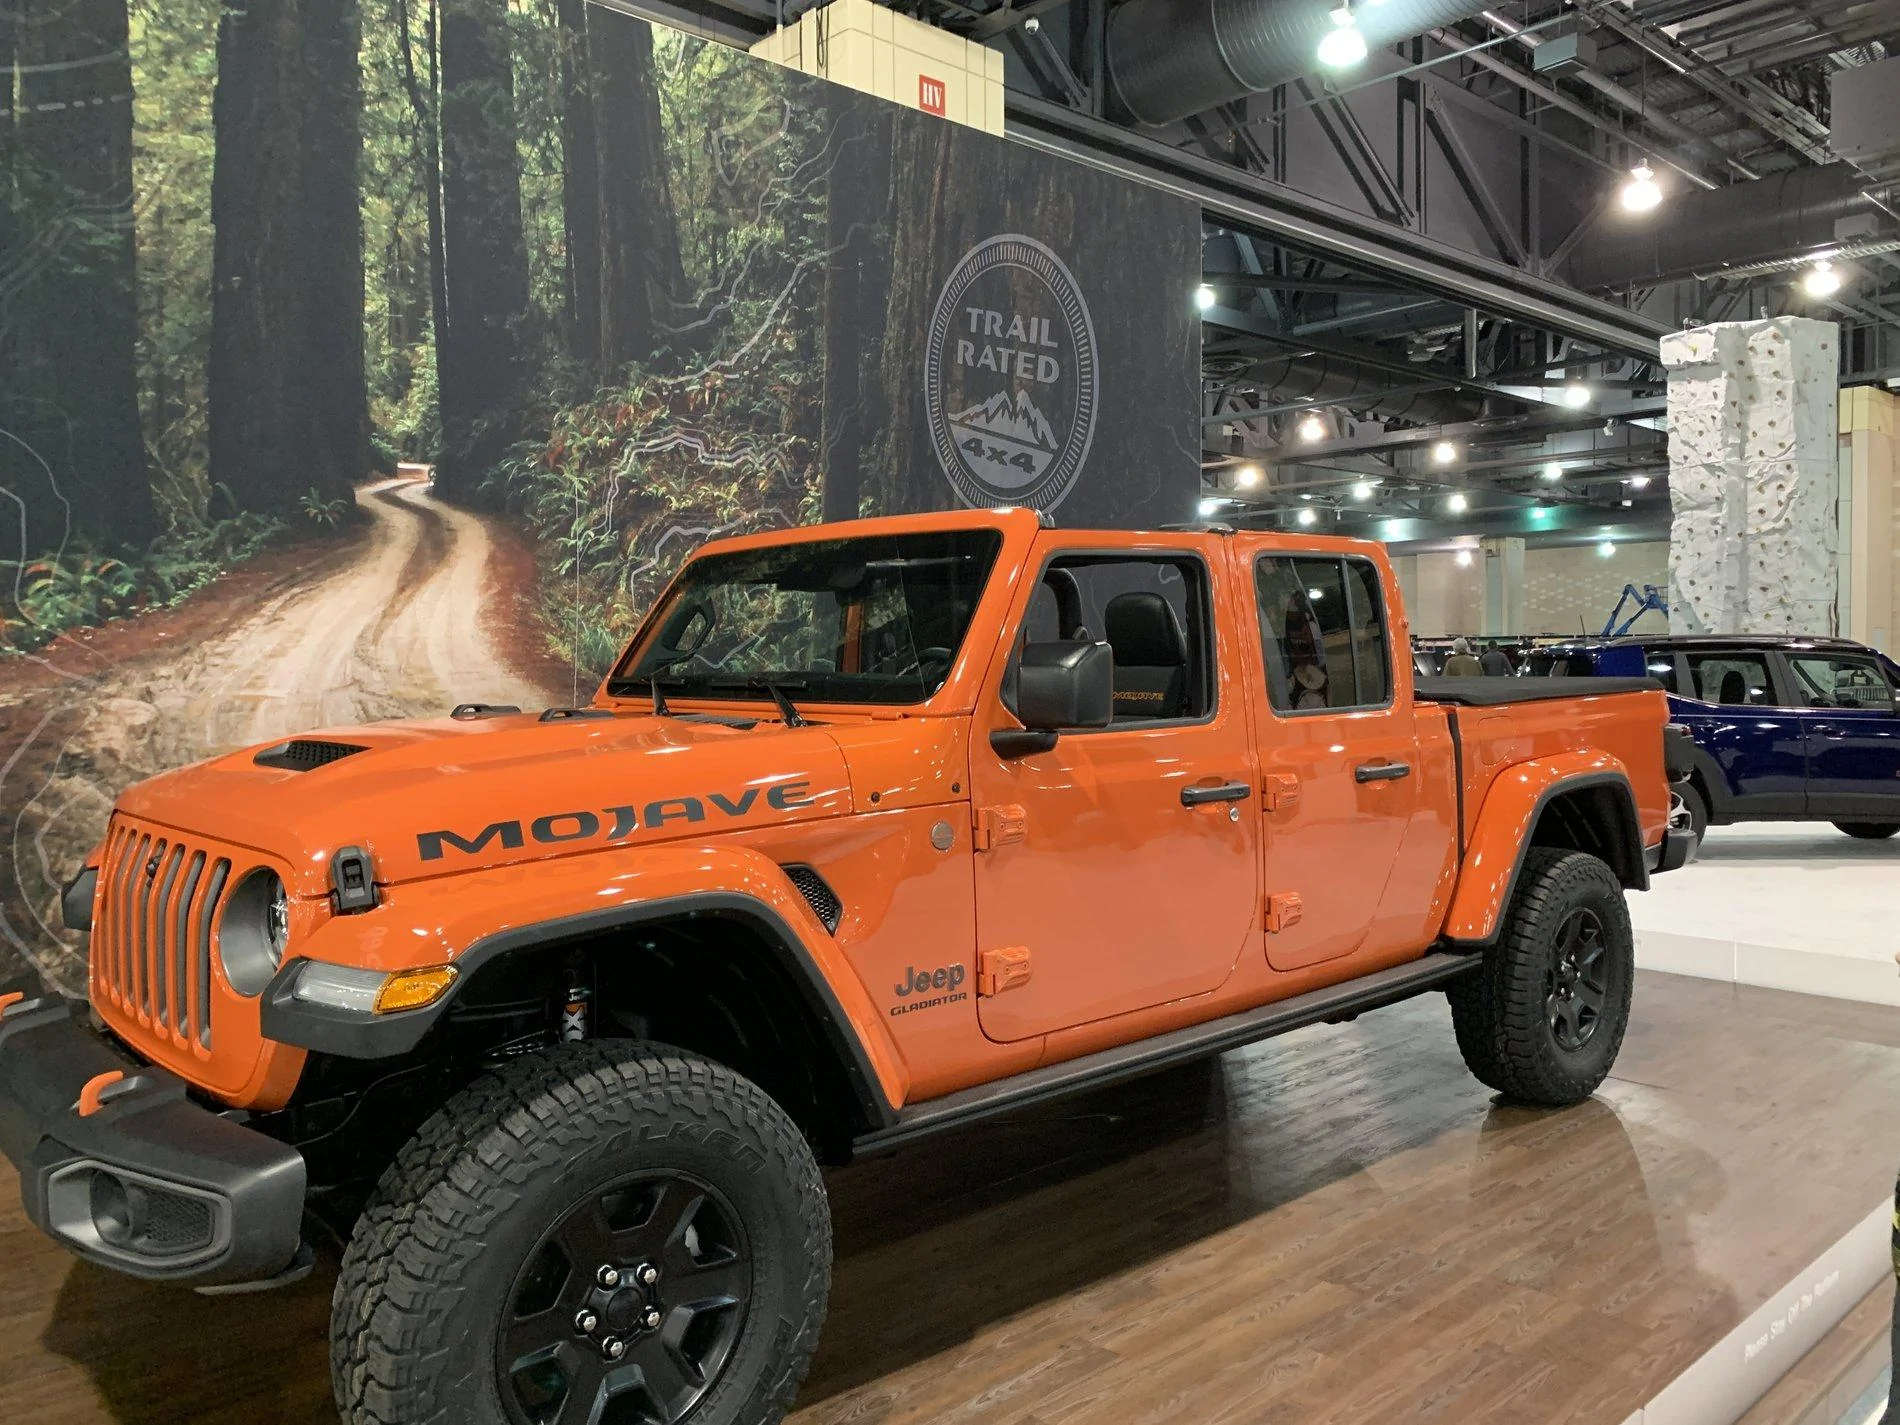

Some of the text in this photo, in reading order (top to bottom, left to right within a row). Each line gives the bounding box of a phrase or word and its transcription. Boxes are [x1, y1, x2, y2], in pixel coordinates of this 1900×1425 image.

[966, 307, 1059, 349] TRAIL
[957, 339, 1060, 384] RATED
[416, 780, 816, 862] MOJAVE
[895, 963, 965, 997] Jeep
[890, 992, 967, 1017] GLADIATOR
